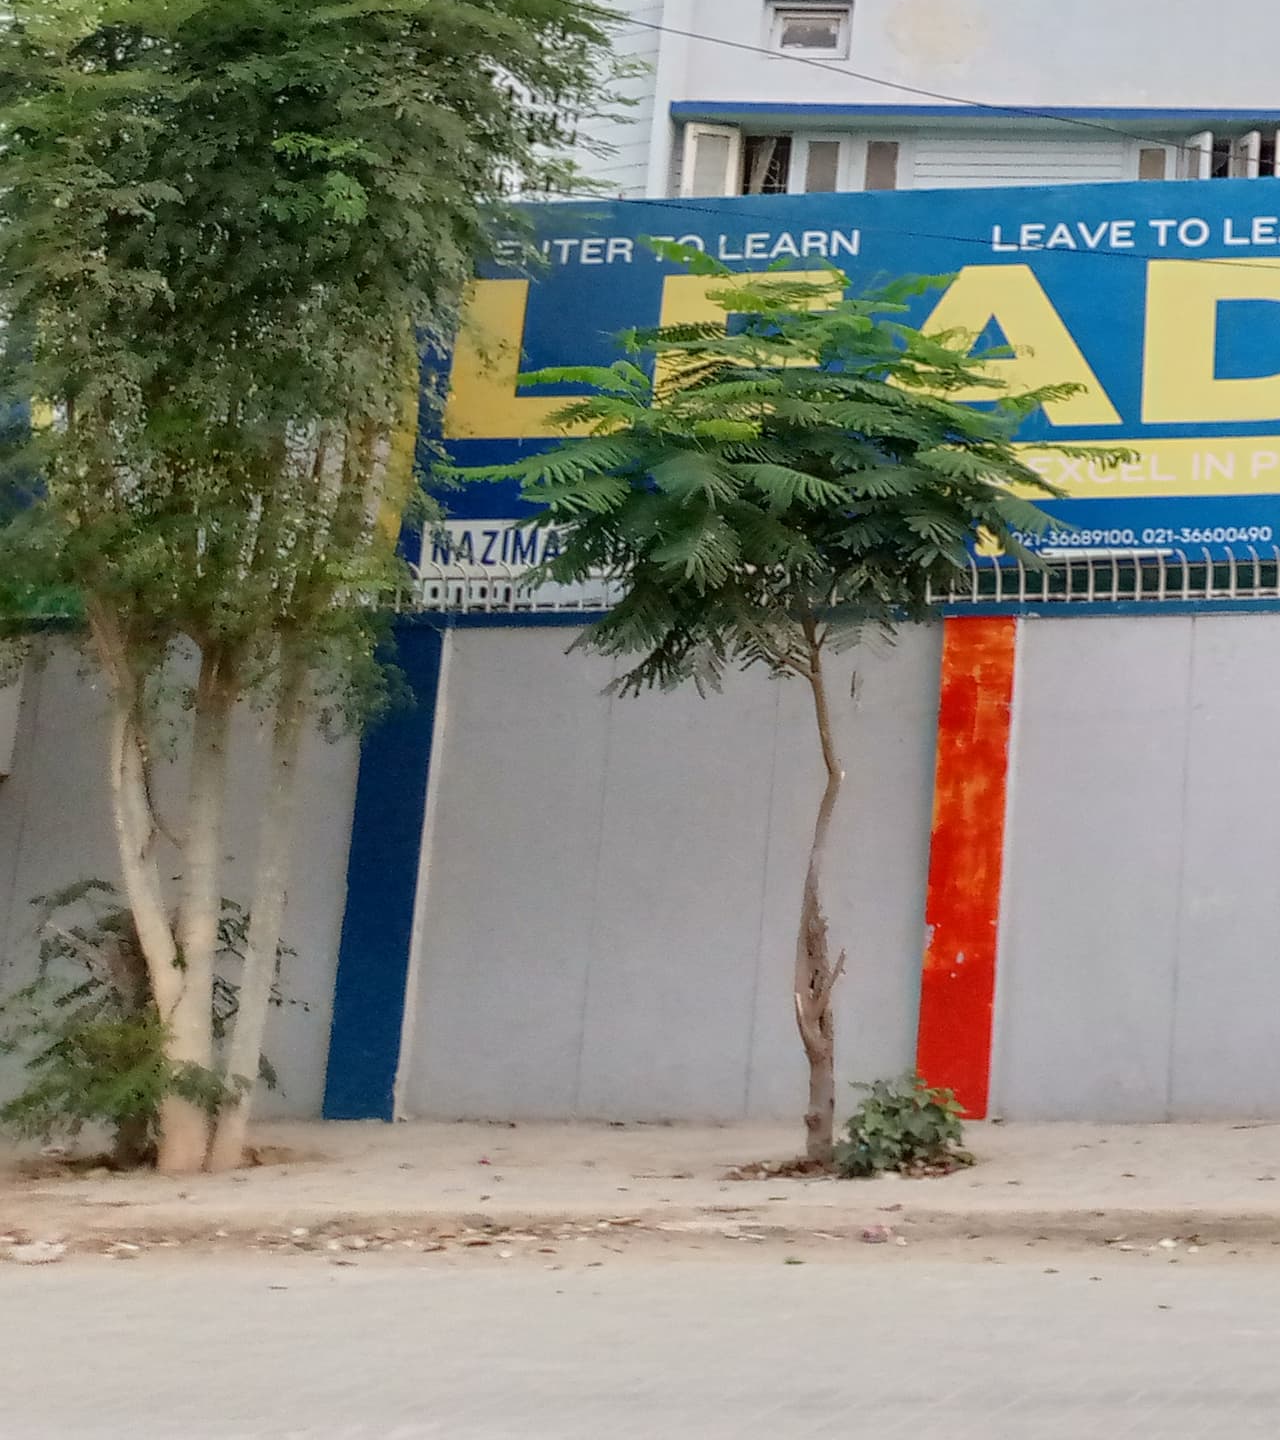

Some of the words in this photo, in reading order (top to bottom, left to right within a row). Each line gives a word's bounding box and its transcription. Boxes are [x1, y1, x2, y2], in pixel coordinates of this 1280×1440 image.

[717, 228, 862, 261] LEARN
[991, 219, 1135, 254] LEAVE
[1143, 217, 1210, 248] TO
[1190, 450, 1235, 482] IN
[1141, 526, 1274, 545] 021-36600490
